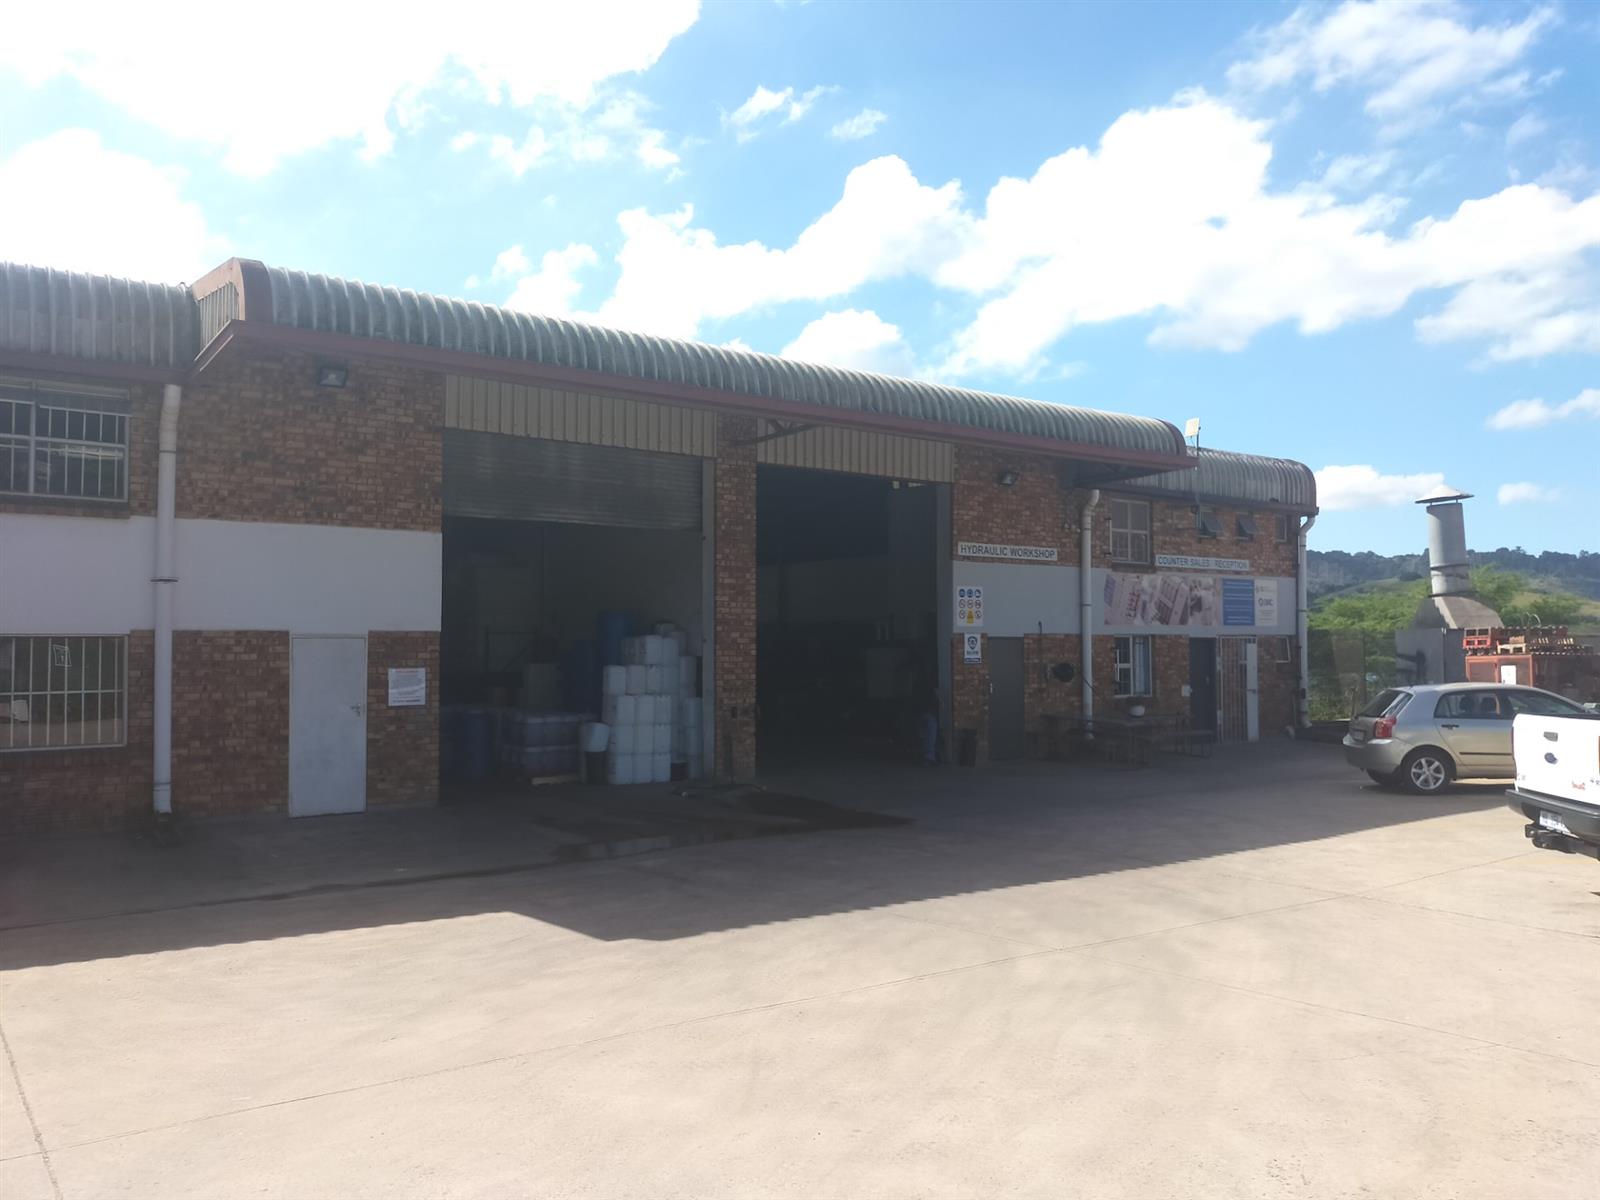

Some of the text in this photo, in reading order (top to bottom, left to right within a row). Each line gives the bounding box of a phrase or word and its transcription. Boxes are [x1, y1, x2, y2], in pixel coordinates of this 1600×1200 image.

[960, 543, 1056, 559] HYDRAULIC WORKSHOP
[1158, 556, 1247, 570] COUNTER SALES RECEPTION
